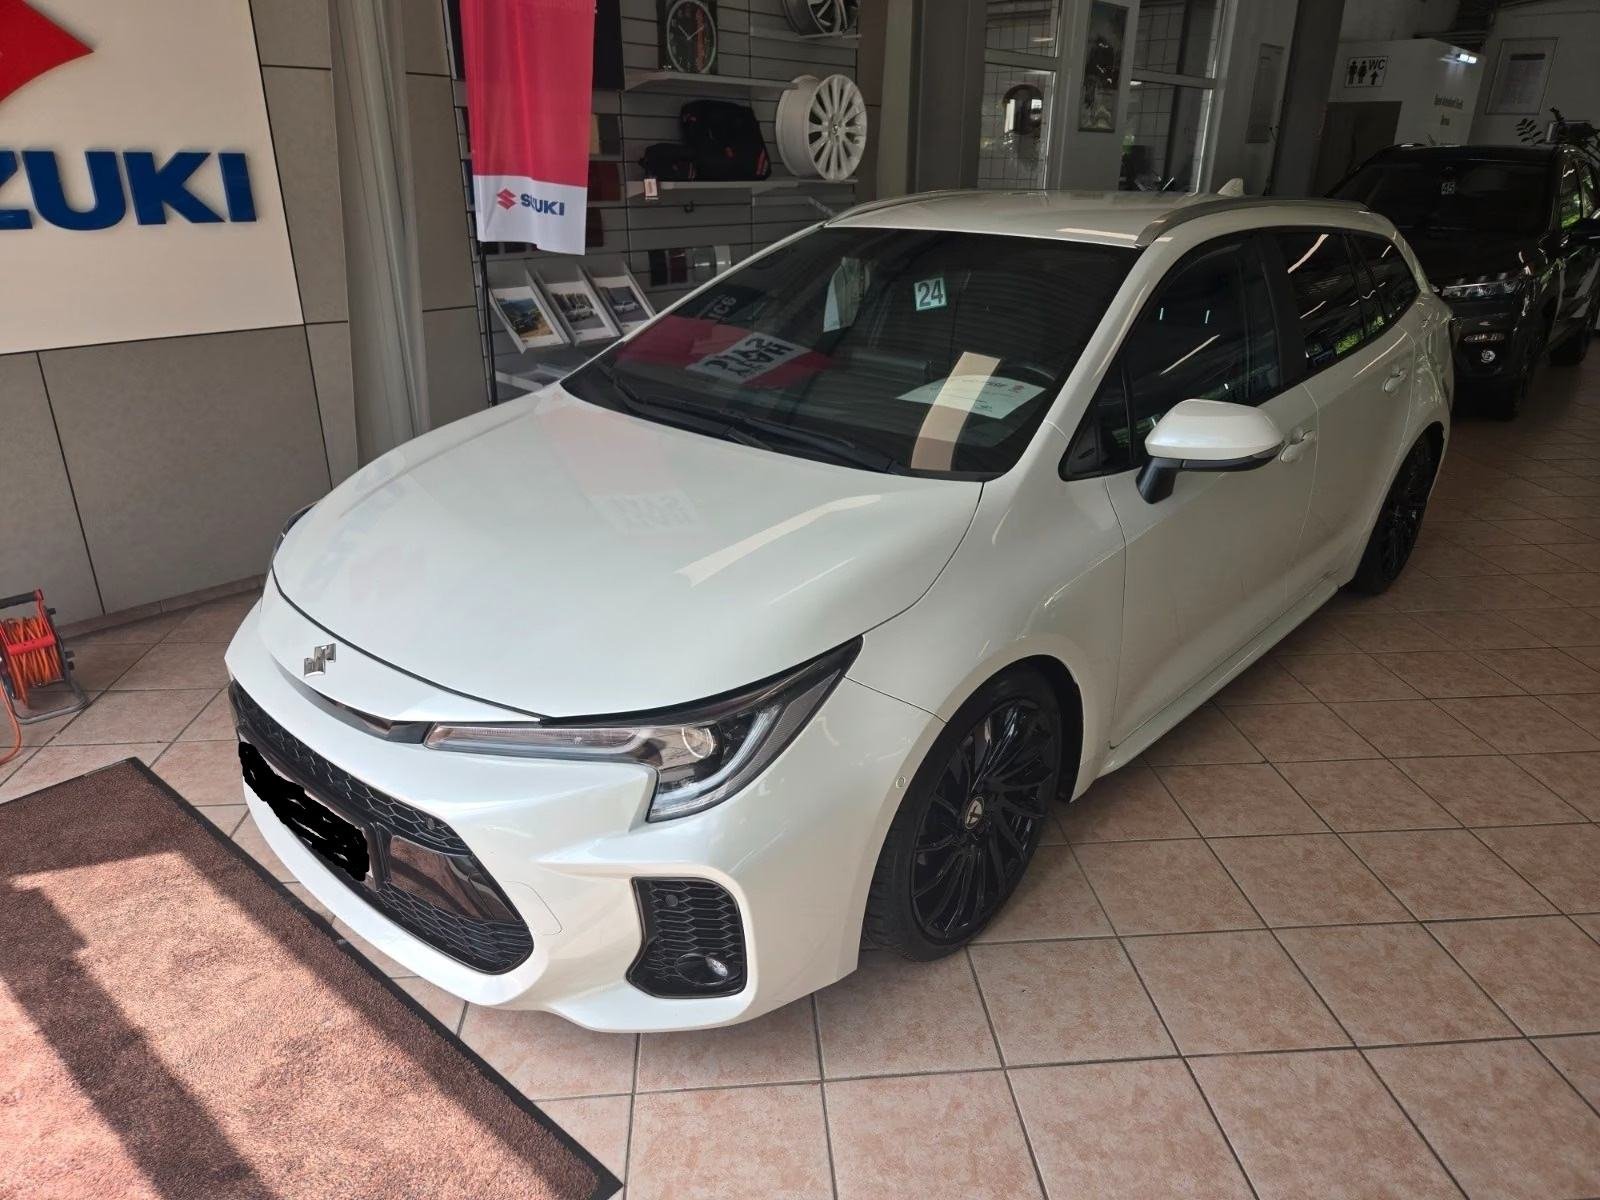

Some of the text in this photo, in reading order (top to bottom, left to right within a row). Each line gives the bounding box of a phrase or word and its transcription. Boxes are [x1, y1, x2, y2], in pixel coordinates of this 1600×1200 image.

[1368, 59, 1385, 70] WC
[520, 193, 565, 216] SUKI
[918, 280, 943, 307] 24
